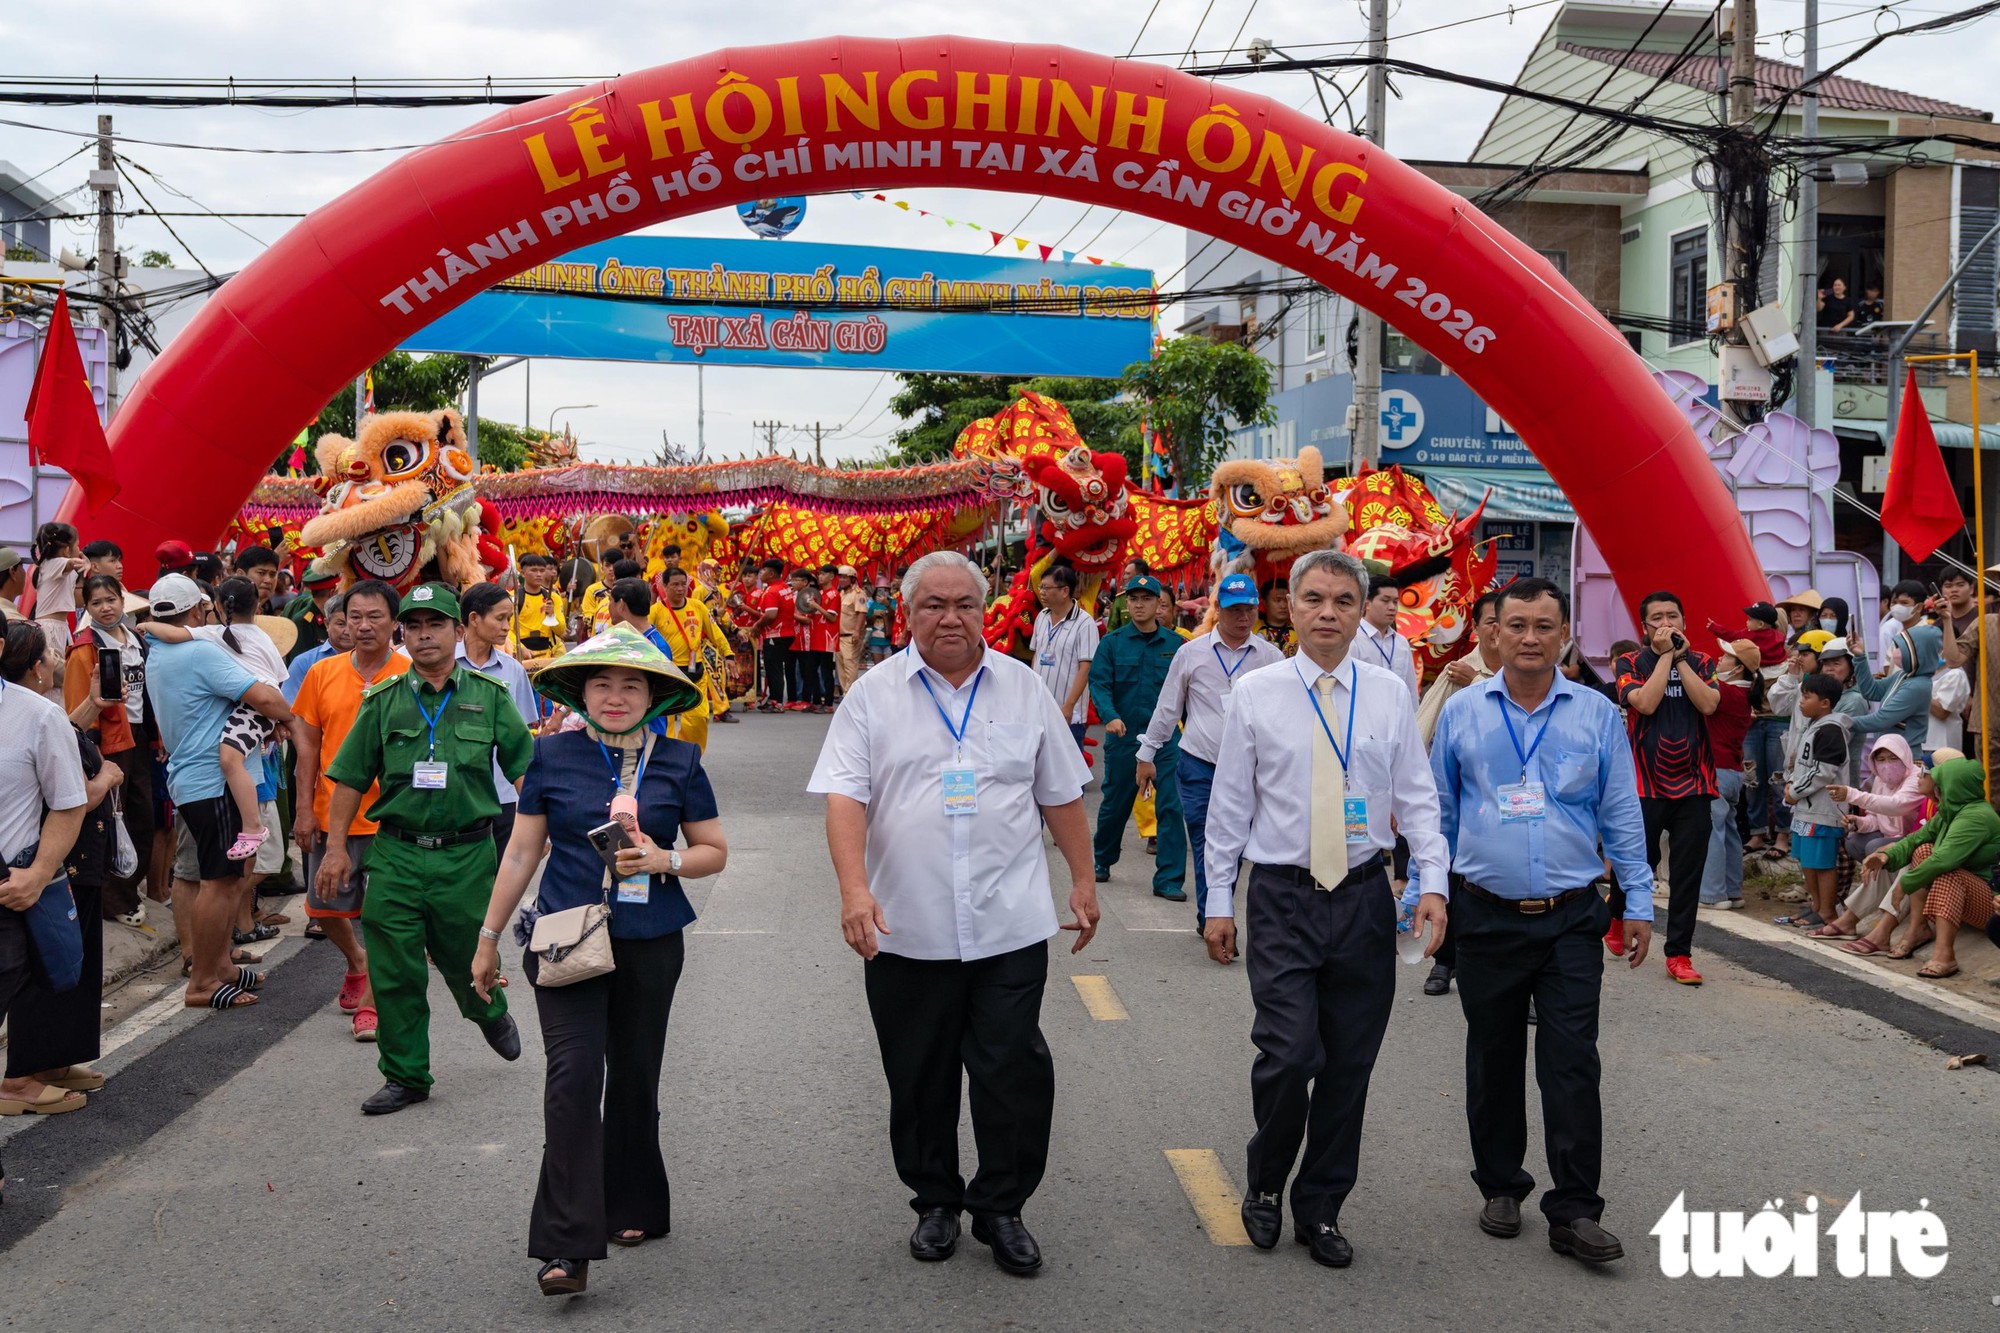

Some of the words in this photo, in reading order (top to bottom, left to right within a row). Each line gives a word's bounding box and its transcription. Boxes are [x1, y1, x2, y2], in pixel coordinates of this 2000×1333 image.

[523, 96, 626, 194] LỄ
[639, 71, 807, 161] HỘI
[819, 69, 1168, 155] NGHINH
[1187, 104, 1369, 225] ÔNG
[379, 219, 540, 316] THÀNH
[652, 151, 722, 202] HỒ
[733, 137, 813, 182] CHÍ
[823, 140, 942, 171] MINH
[952, 141, 1026, 178] TẠI
[1035, 145, 1100, 184] XÃ
[1112, 158, 1211, 208] CẦN
[1217, 198, 1301, 237] GIỜ
[1297, 222, 1399, 290] NĂM
[1394, 277, 1497, 354] 2026
[601, 257, 664, 297] ÔNG
[667, 263, 770, 300] THÀNH
[773, 264, 836, 303] PHỐ
[837, 265, 881, 305] HỒ
[885, 272, 936, 308] CHÍ
[937, 279, 1011, 314] MINH
[1014, 279, 1081, 315] NĂM
[1084, 286, 1152, 318] 2026
[667, 314, 720, 356] TẠI
[721, 314, 768, 349] XÃ
[770, 310, 831, 352] CẦN
[833, 315, 887, 353] GIỜ
[1430, 436, 1486, 450] CHUYÊN:
[1430, 452, 1446, 462] 149
[1486, 454, 1499, 463] KP
